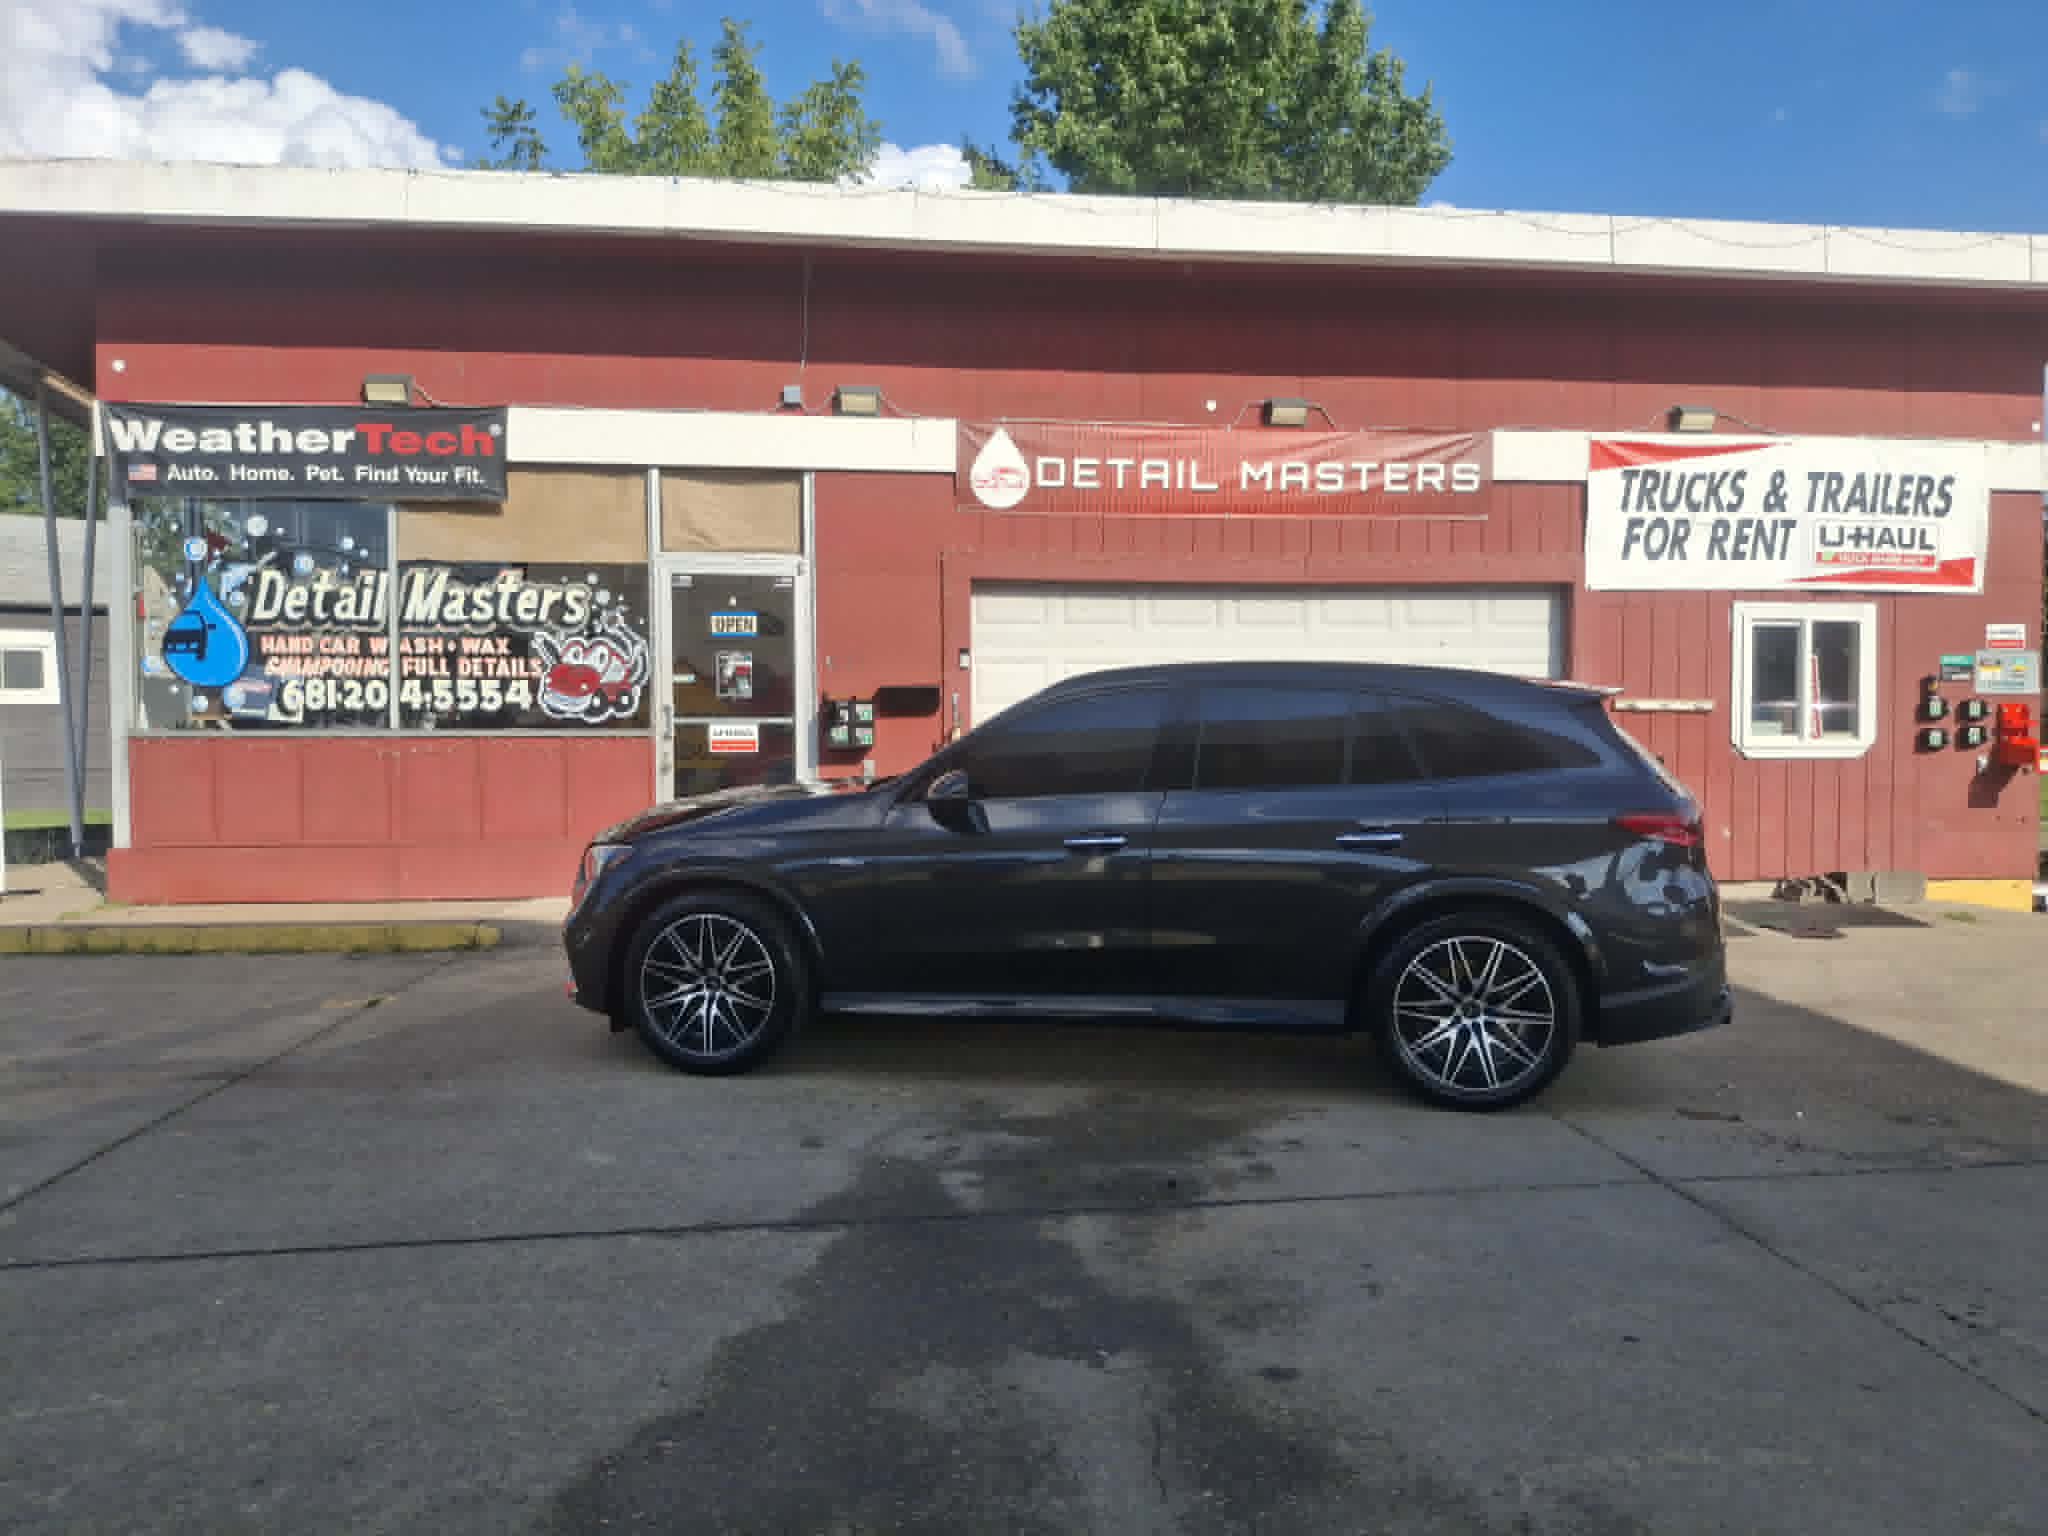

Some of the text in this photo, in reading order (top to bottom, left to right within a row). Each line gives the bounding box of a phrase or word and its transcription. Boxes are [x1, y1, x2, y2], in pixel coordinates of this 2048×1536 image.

[107, 420, 495, 456] WeatherTech
[167, 463, 486, 484] Auto. Home. Pet. Find Your Fit.
[1036, 456, 1481, 493] DETAIL MASTERS
[1619, 468, 1956, 518] TRUCKS & TRAILERS
[1621, 517, 1798, 561] FOR RENT
[1819, 525, 1937, 551] U-HAUL
[253, 567, 588, 625] Detail Masters
[712, 616, 753, 632] OPEN
[260, 634, 312, 655] HAND
[319, 635, 361, 656] CAR
[461, 636, 512, 655] WAX
[401, 655, 450, 677] FULL
[456, 656, 543, 678] DETAILS
